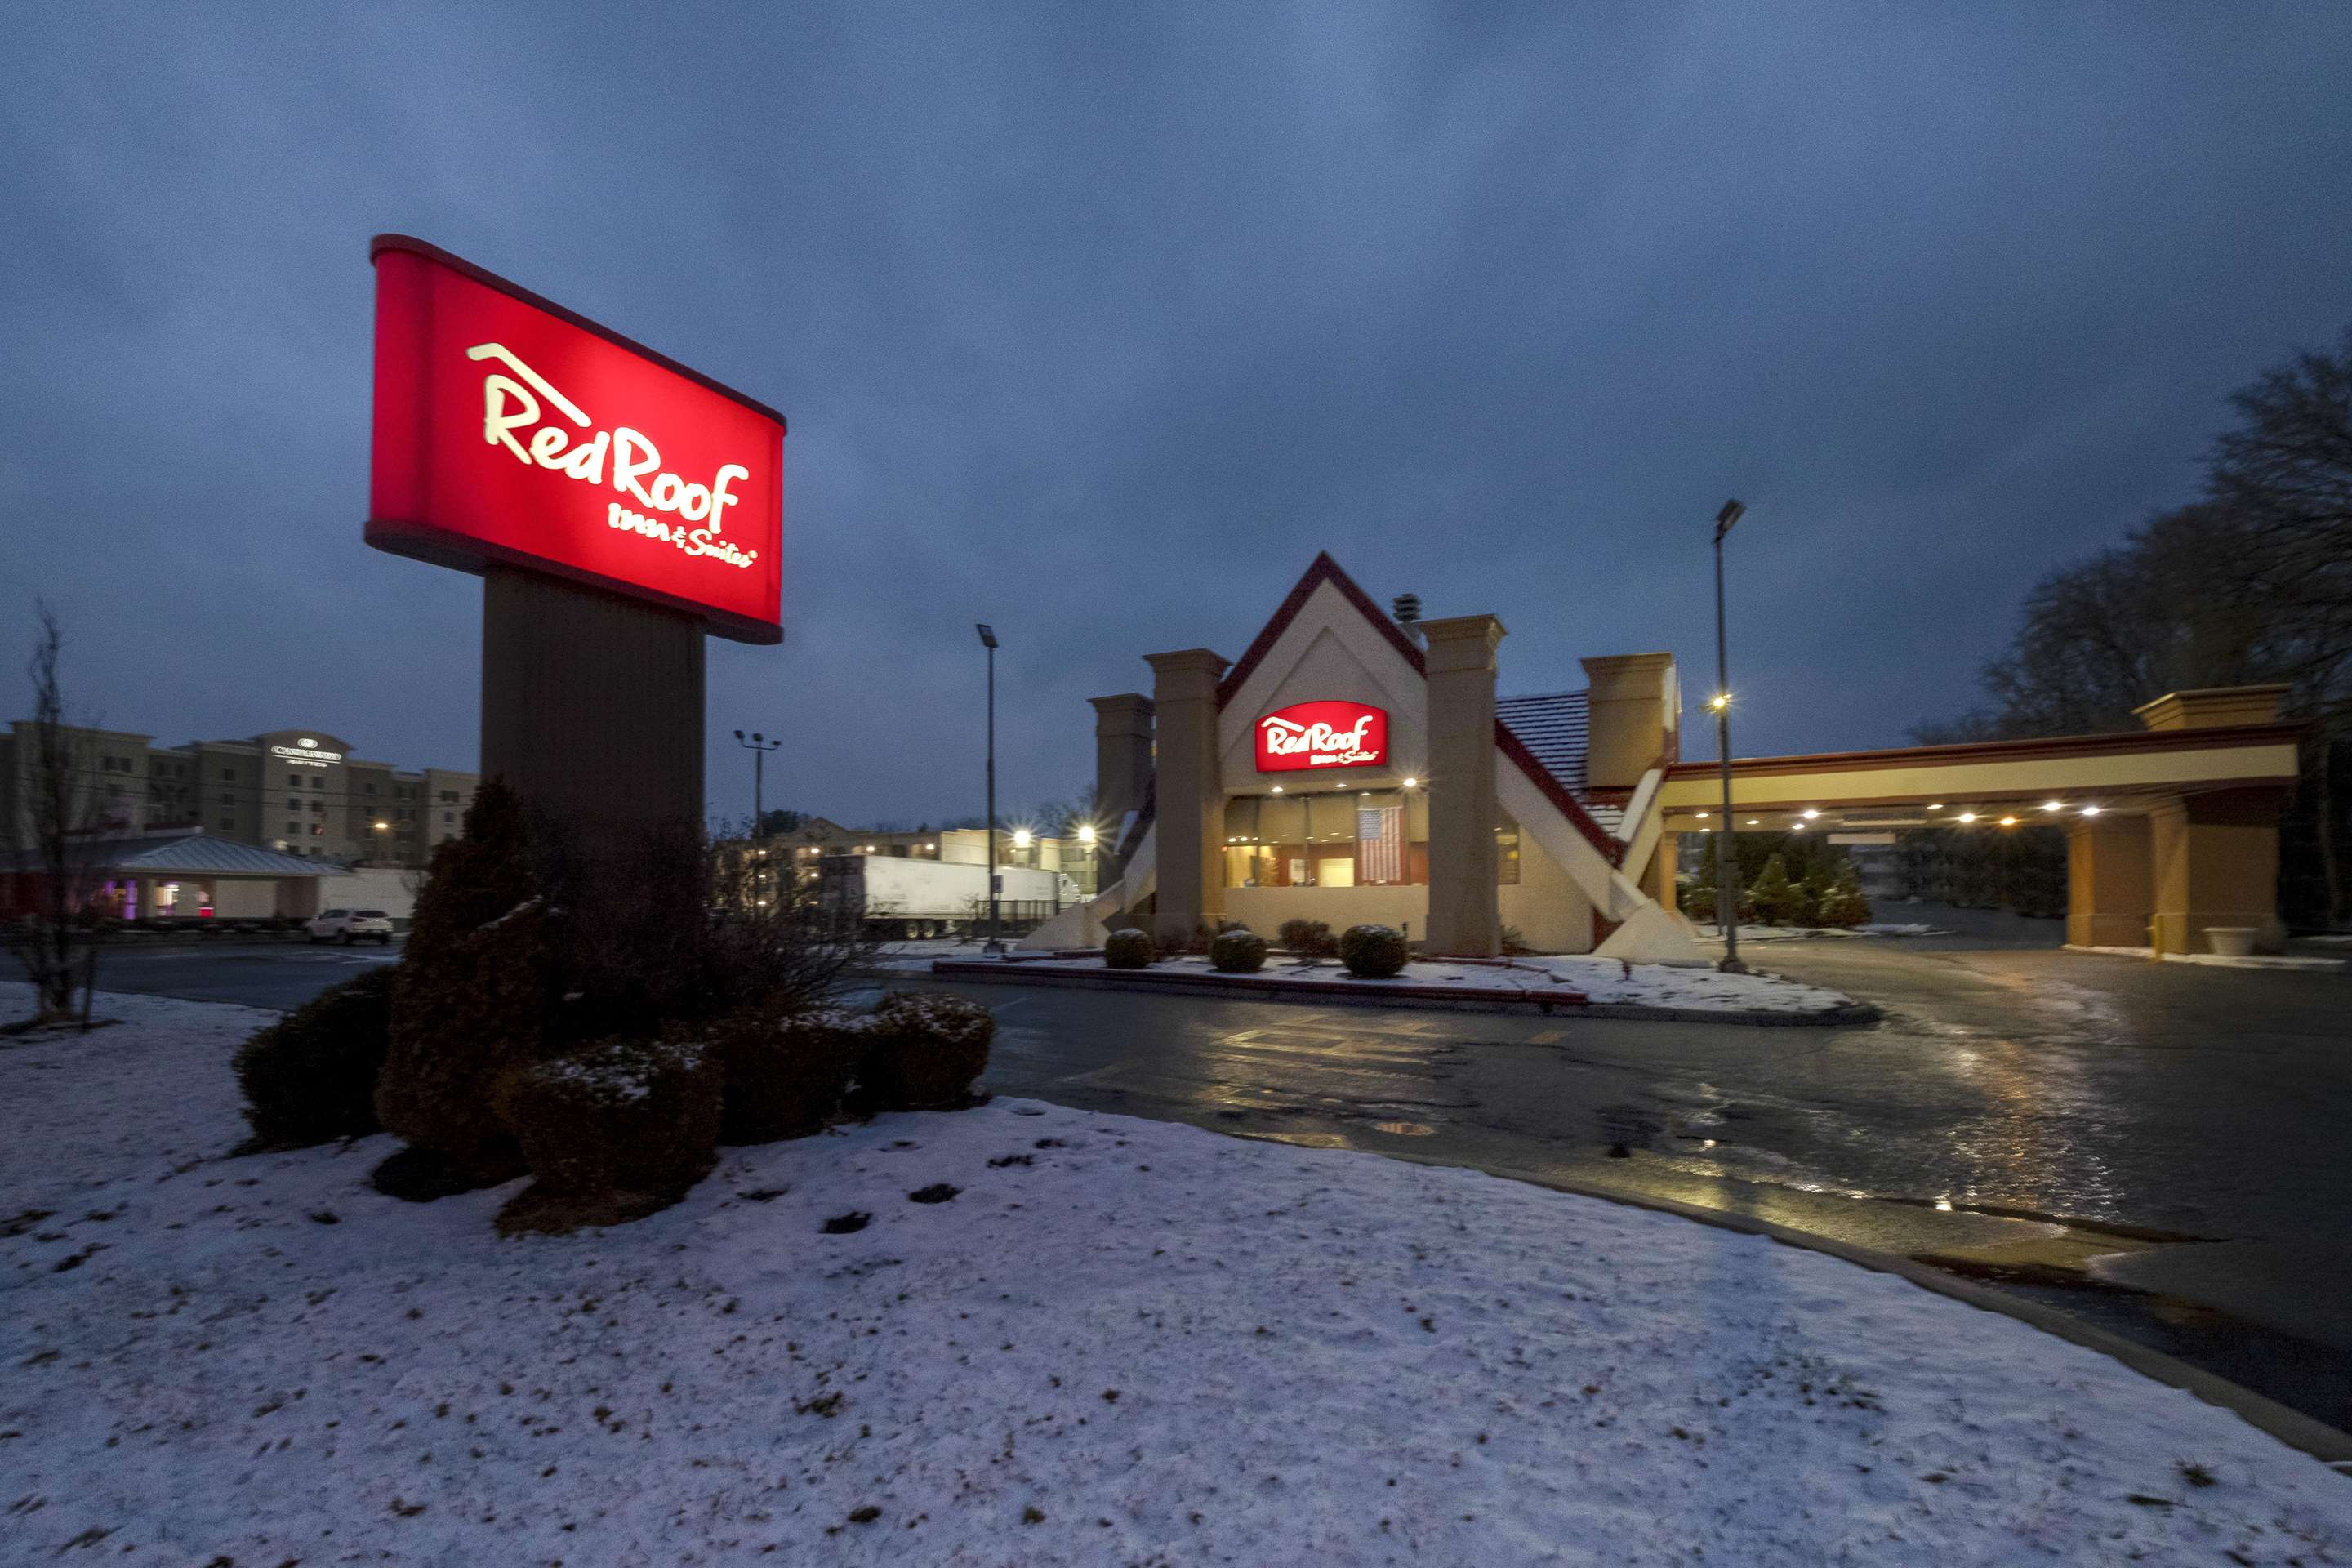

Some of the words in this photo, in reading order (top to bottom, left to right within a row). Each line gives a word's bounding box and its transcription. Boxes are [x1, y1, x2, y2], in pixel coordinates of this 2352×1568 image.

[484, 374, 611, 485] Red
[612, 426, 750, 535] Roof
[608, 502, 671, 542] Inn
[671, 525, 687, 549] &
[684, 528, 754, 568] Suites
[1267, 727, 1312, 755] Red
[1311, 715, 1374, 752] Roof
